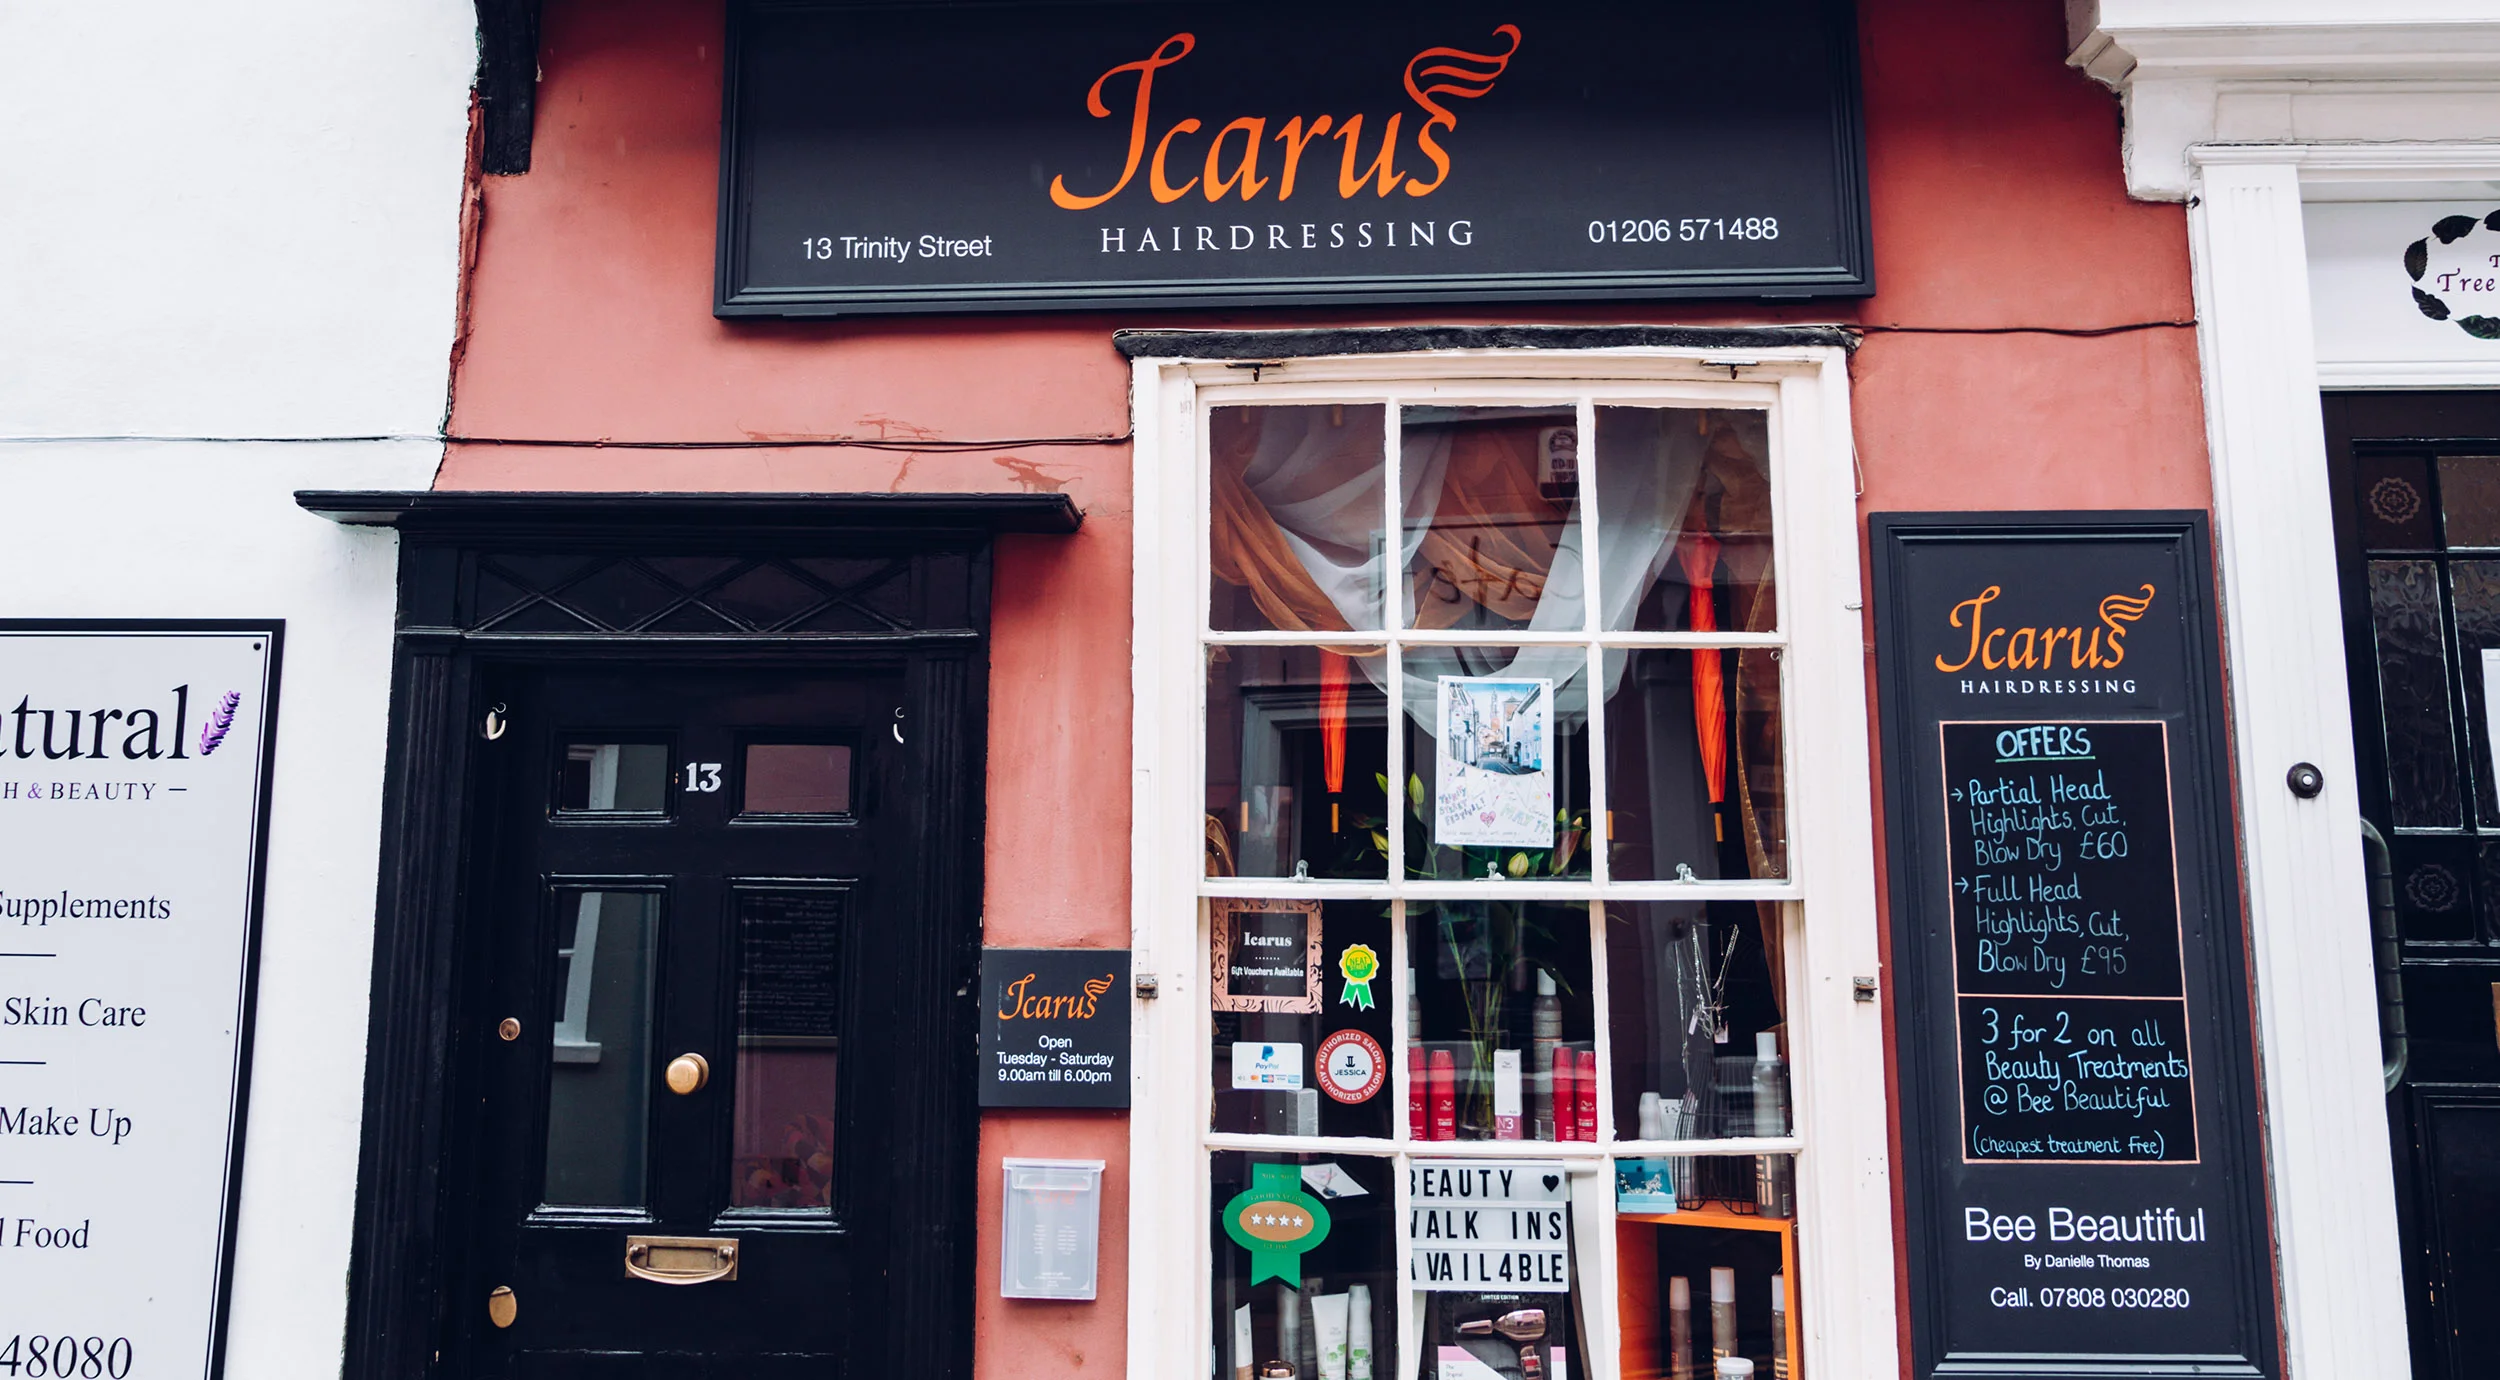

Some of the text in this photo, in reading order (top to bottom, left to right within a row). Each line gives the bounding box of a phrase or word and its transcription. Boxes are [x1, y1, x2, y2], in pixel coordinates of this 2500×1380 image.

[1050, 25, 1521, 210] Icarus
[1101, 221, 1472, 252] HAIRDRESSING
[1589, 217, 1778, 243] 01206 571488
[803, 235, 992, 263] 13 Trinity Street
[2437, 268, 2495, 291] Tree
[1935, 584, 2155, 672] Icarus
[1961, 680, 2135, 693] HAIRDRESSING
[0, 684, 189, 759] tural
[1995, 725, 2092, 757] OFFERS
[28, 783, 41, 799] &
[51, 783, 155, 800] BEAUTY
[686, 763, 721, 792] 13
[1968, 768, 2112, 807] Partial Head
[1974, 830, 2128, 871] Blow Dry £60
[1973, 872, 2082, 903] Full Head
[0, 891, 170, 925] upplements
[1245, 932, 1292, 946] Icarus
[1976, 905, 2130, 946] Highlights, Cut,
[1978, 938, 2127, 989] Blow Dry £95
[4, 997, 145, 1026] Skin Care
[998, 972, 1115, 1021] Icarus
[1039, 1035, 1072, 1050] Open
[1981, 1007, 2166, 1050] 3 for 2 on all
[997, 1052, 1047, 1067] Tuesday
[1060, 1052, 1113, 1067] Saturday
[1320, 1032, 1381, 1064] AUTHORIZED SALON
[998, 1069, 1111, 1084] 9.00am till 6.00pm
[1985, 1049, 2189, 1091] Beauty Treatments
[1320, 1071, 1382, 1101] AUTHORIZED SALON
[1983, 1080, 2171, 1119] @ Bee Beautiful
[0, 1107, 131, 1144] Make Up
[1973, 1125, 2044, 1159] (cheapest
[2047, 1134, 2122, 1154] treatment
[16, 1219, 89, 1248] Food
[1512, 1211, 1561, 1240] INS
[1965, 1208, 2205, 1241] Bee Beautiful
[2025, 1255, 2149, 1270] By Danielle Thomas
[1991, 1287, 2189, 1308] Call. 07808 030280
[0, 1335, 132, 1380] 48080
